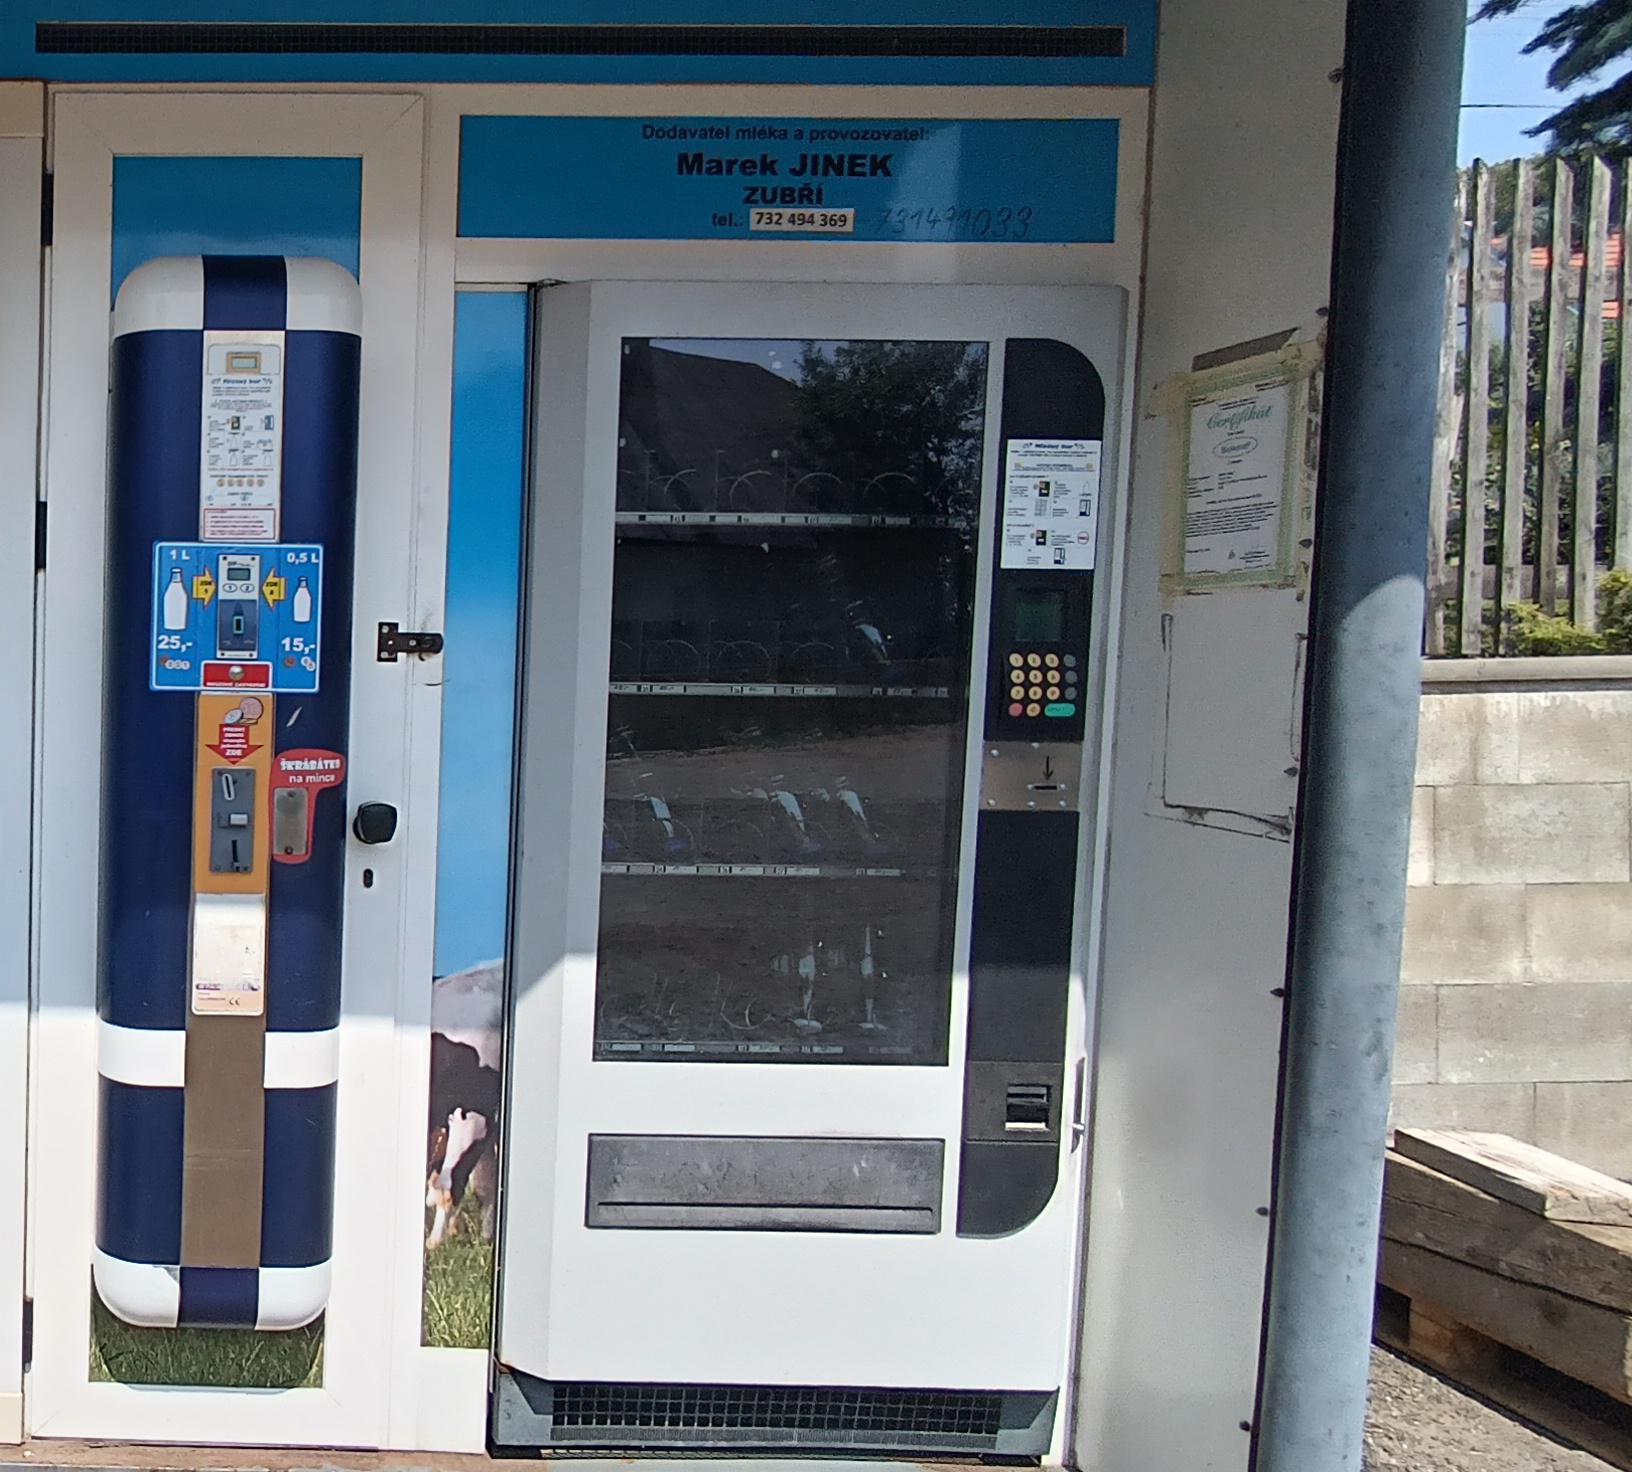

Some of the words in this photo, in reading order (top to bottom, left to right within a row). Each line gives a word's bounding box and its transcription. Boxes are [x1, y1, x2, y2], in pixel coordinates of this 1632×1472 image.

[642, 124, 730, 140] Dodavatel
[735, 125, 788, 140] mléka
[793, 130, 804, 140] a
[677, 152, 779, 176] Marek
[789, 153, 893, 177] JINEK
[742, 183, 824, 205] ZUBŘÍ
[712, 212, 744, 227] tel.:
[755, 212, 783, 225] 732
[787, 213, 815, 226] 494
[819, 213, 847, 227] 369
[169, 550, 177, 560] 1
[182, 551, 190, 560] L
[287, 553, 308, 565] 0,5
[311, 553, 319, 563] L
[158, 635, 193, 652] 25,-
[281, 637, 316, 654] 15,-
[289, 775, 303, 783] na
[305, 772, 336, 783] mince
